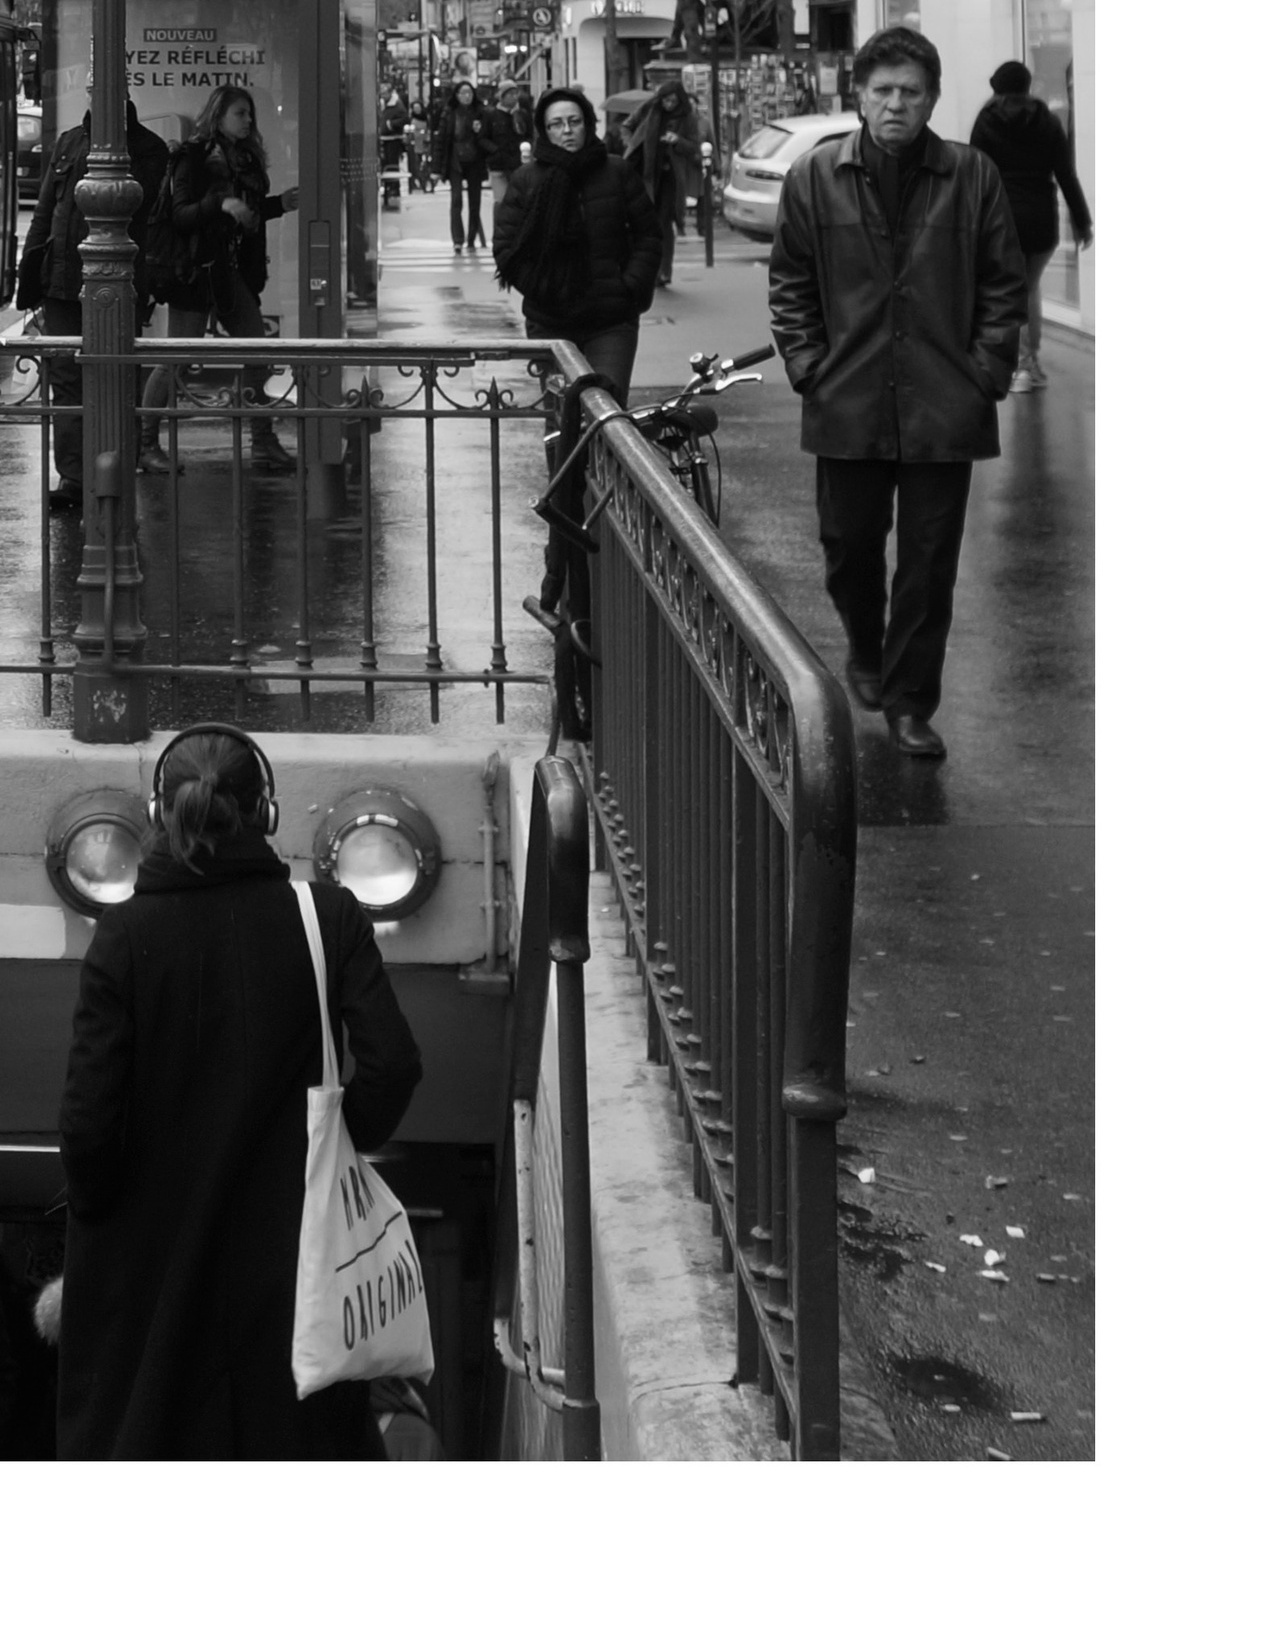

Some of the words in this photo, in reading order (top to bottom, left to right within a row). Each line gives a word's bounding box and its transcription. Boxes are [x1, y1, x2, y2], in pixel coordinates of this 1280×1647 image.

[146, 30, 214, 41] NOUVEAU
[167, 46, 265, 65] RÉFLÉCHI
[152, 72, 174, 86] LE
[182, 72, 254, 87] MATIN.
